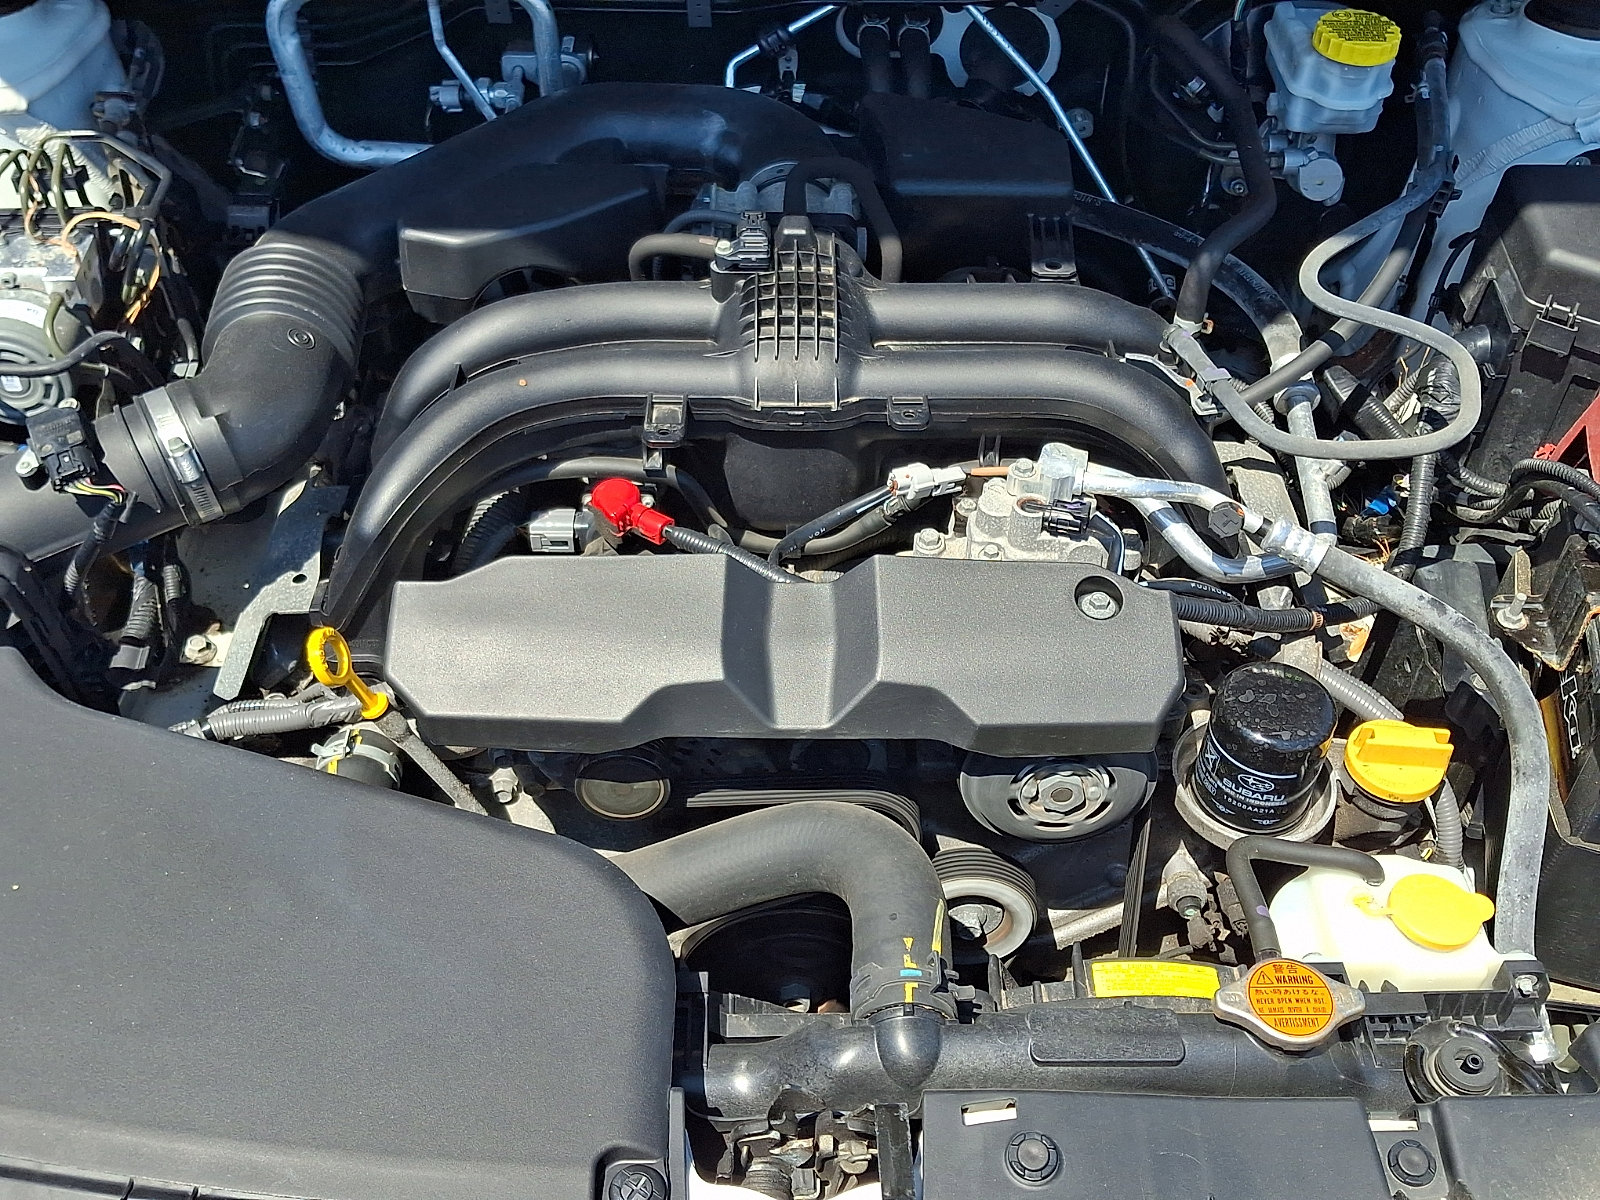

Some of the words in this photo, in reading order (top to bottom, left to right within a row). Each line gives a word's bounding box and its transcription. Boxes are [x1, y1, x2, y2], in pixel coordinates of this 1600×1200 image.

[1217, 780, 1236, 797] MADE
[1236, 792, 1245, 801] IN
[1246, 796, 1288, 807] INDONESIA
[1222, 778, 1285, 801] SUBARU
[1272, 964, 1298, 974] 警告
[1274, 975, 1314, 985] WARNING
